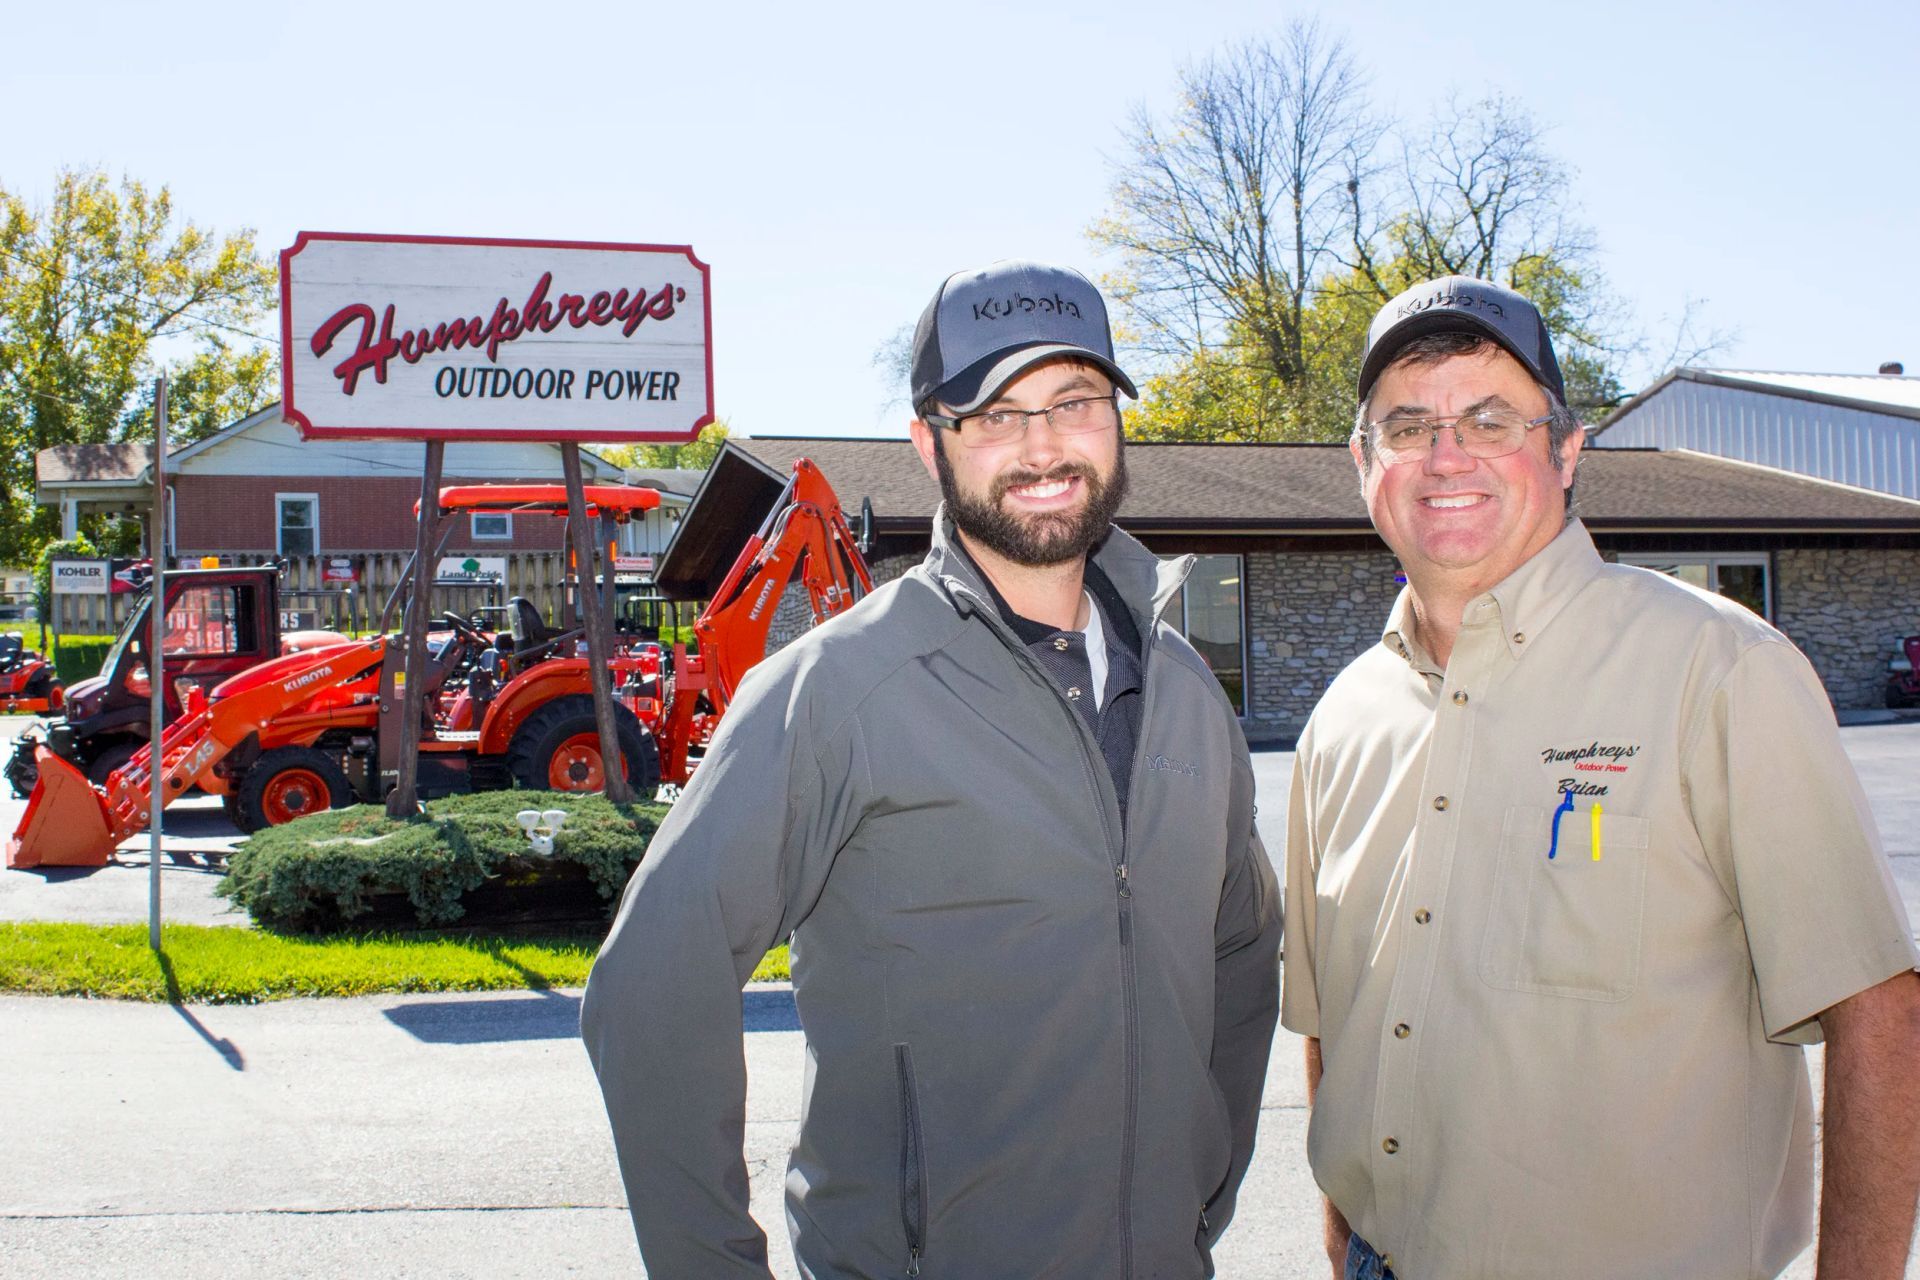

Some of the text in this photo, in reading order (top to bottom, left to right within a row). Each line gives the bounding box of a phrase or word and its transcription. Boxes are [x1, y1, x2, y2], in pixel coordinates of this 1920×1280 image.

[973, 292, 1083, 320] Kubota
[1397, 291, 1504, 319] Kubota
[310, 271, 686, 397] Humphreys'
[435, 366, 681, 401] OUTDOOR POWER
[58, 567, 101, 577] KOHLER
[475, 570, 503, 579] Pride
[747, 578, 776, 621] KUBOTA
[283, 666, 333, 693] KUBOTA
[1541, 741, 1641, 764] Humphreys'
[1574, 762, 1628, 773] Outdoor Power
[1557, 778, 1608, 796] Brian
